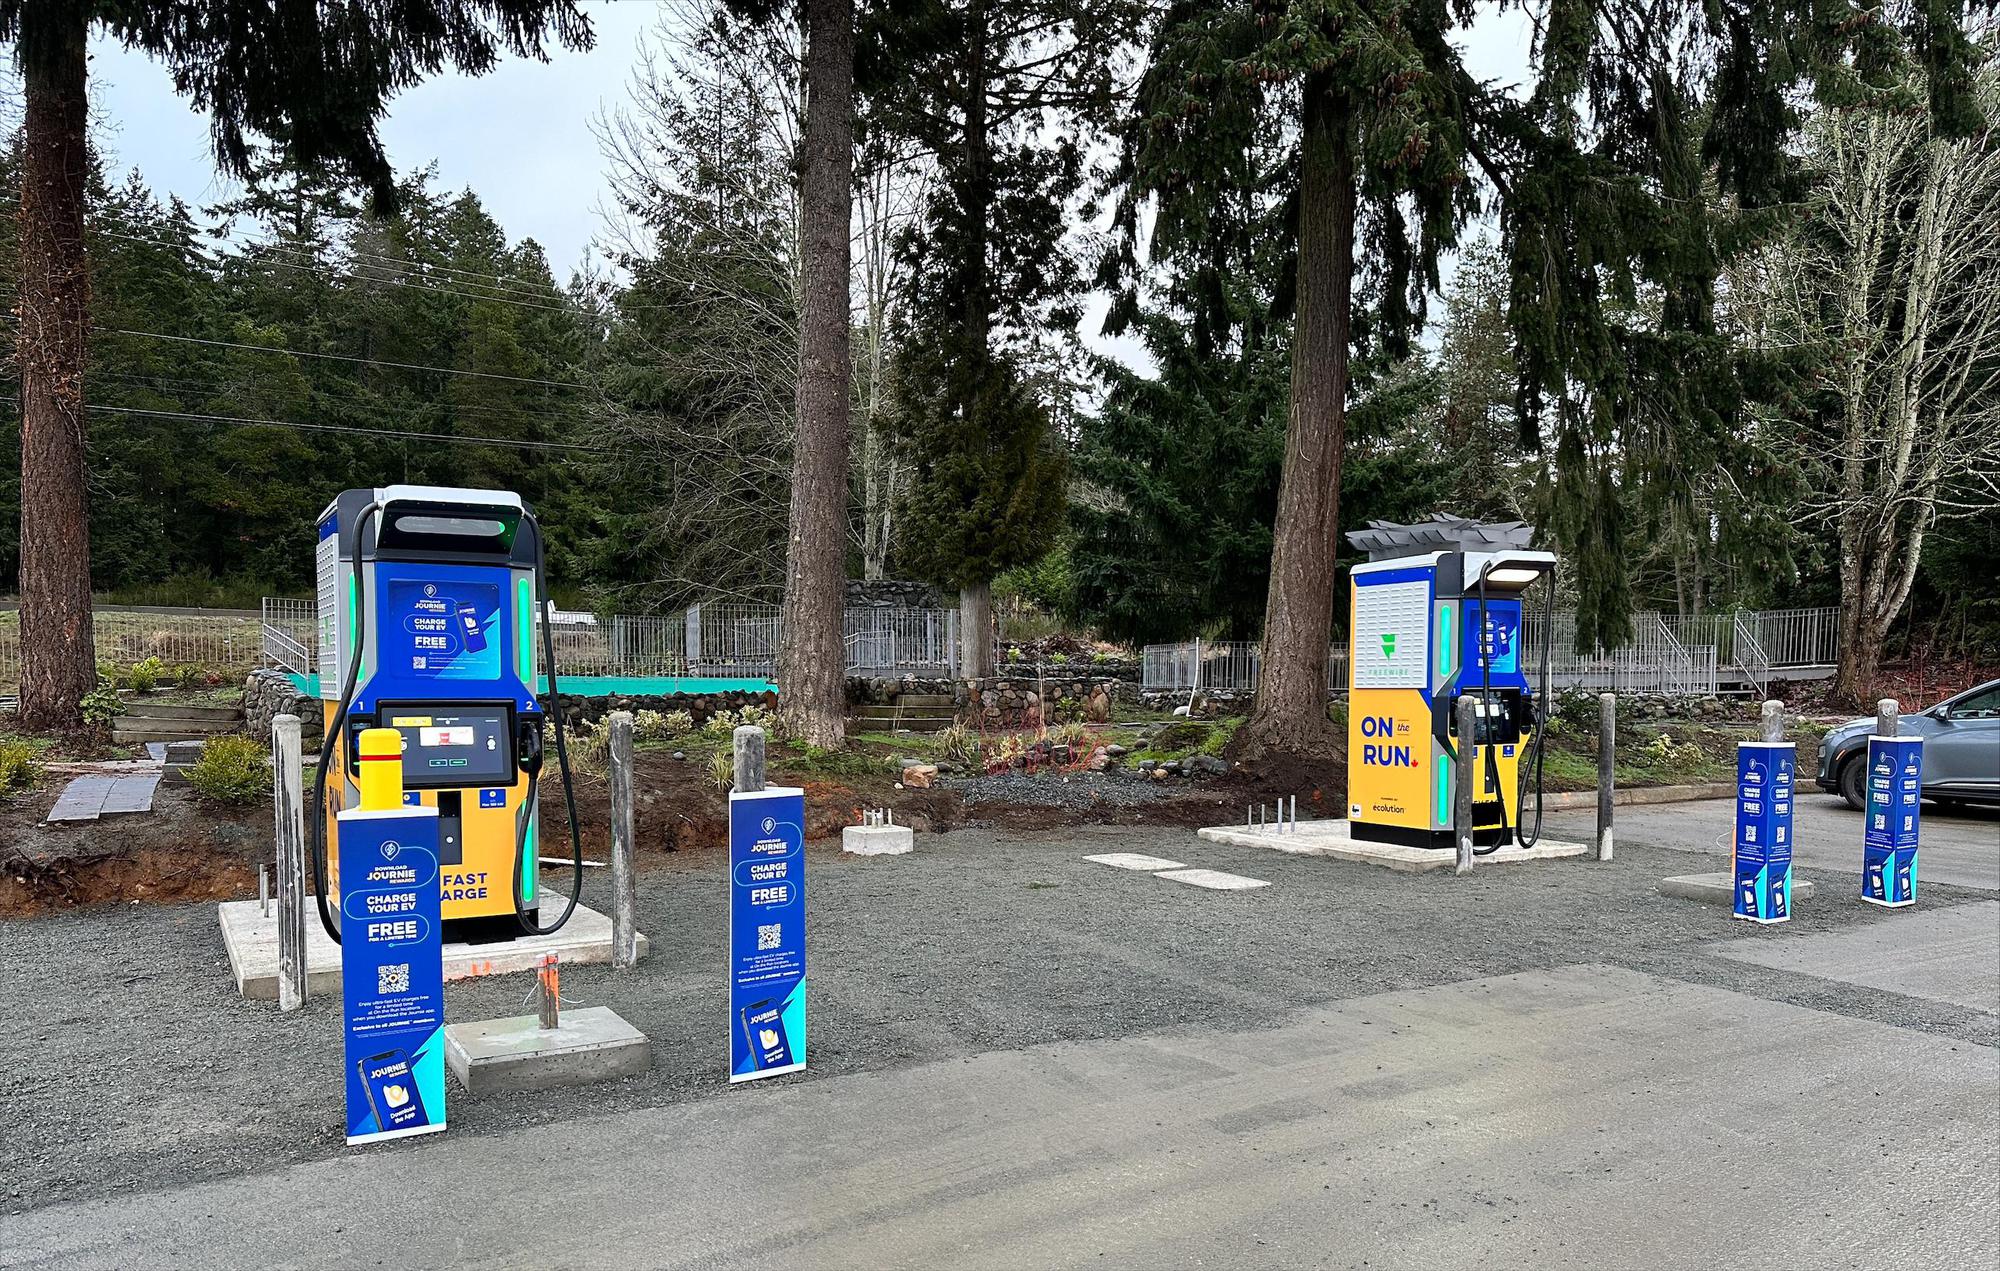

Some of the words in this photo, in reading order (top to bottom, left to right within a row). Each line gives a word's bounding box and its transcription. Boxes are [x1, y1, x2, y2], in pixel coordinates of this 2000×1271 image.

[415, 636, 446, 646] FREE
[359, 701, 364, 710] 1
[526, 701, 533, 710] 2
[1361, 716, 1392, 737] ON
[1397, 723, 1410, 731] the
[1364, 745, 1410, 767] RUN
[1744, 802, 1760, 811] FREE
[751, 842, 787, 852] JOURNIE
[751, 863, 787, 873] CHARGE
[367, 869, 416, 881] JOURNIE
[443, 873, 487, 886] FAST
[751, 872, 774, 880] YOUR
[367, 893, 416, 904] CHARGE
[440, 888, 487, 901] ARGE
[752, 886, 787, 901] FREE
[368, 903, 398, 913] YOUR
[401, 902, 416, 911] EV
[368, 921, 417, 937] FREE
[750, 1009, 778, 1024] JOURNIE
[371, 1061, 407, 1079] JOURNIE
[390, 1105, 416, 1119] Download
[404, 1112, 415, 1120] App
